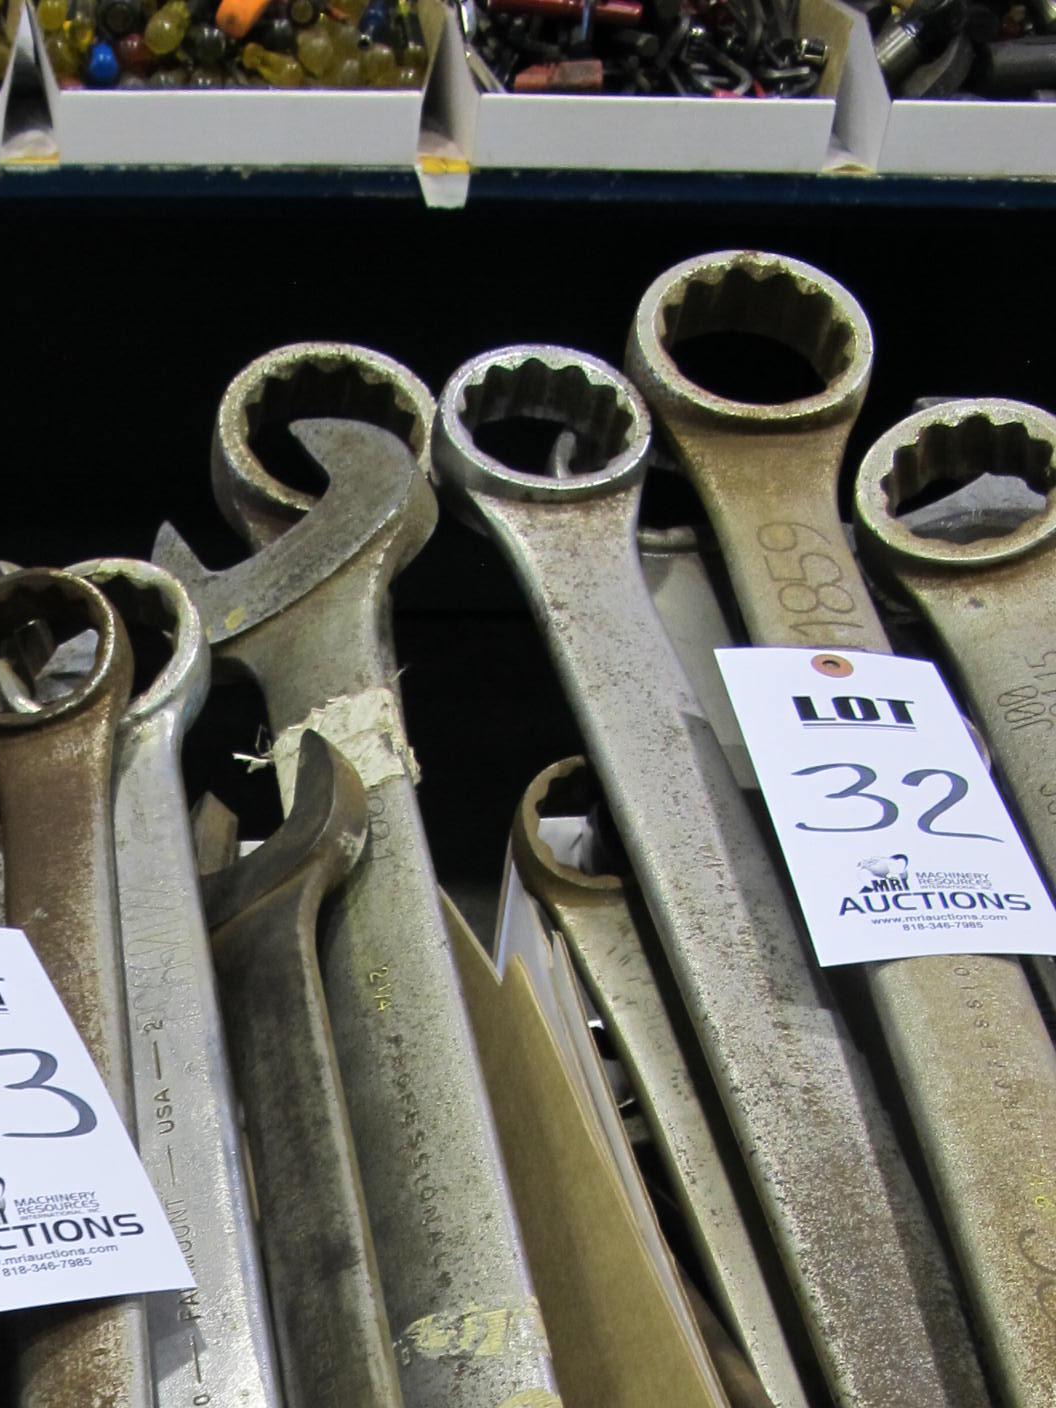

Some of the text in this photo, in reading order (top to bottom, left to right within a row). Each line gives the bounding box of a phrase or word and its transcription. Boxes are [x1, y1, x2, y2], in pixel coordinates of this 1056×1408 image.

[759, 521, 864, 638] 1859
[792, 696, 916, 725] LOT
[792, 762, 1004, 843] 32
[870, 875, 910, 893] MRI
[915, 871, 990, 880] MACHINERY
[839, 891, 1032, 917] AUCTIONS
[871, 913, 1008, 925] www.mriauctions.com
[903, 921, 984, 932] 818-346-7985
[153, 1086, 176, 1135] USA
[13, 1190, 96, 1208] MACHINERY
[16, 1199, 100, 1216] RESOURCES
[1, 1256, 93, 1278] 818-346-7985
